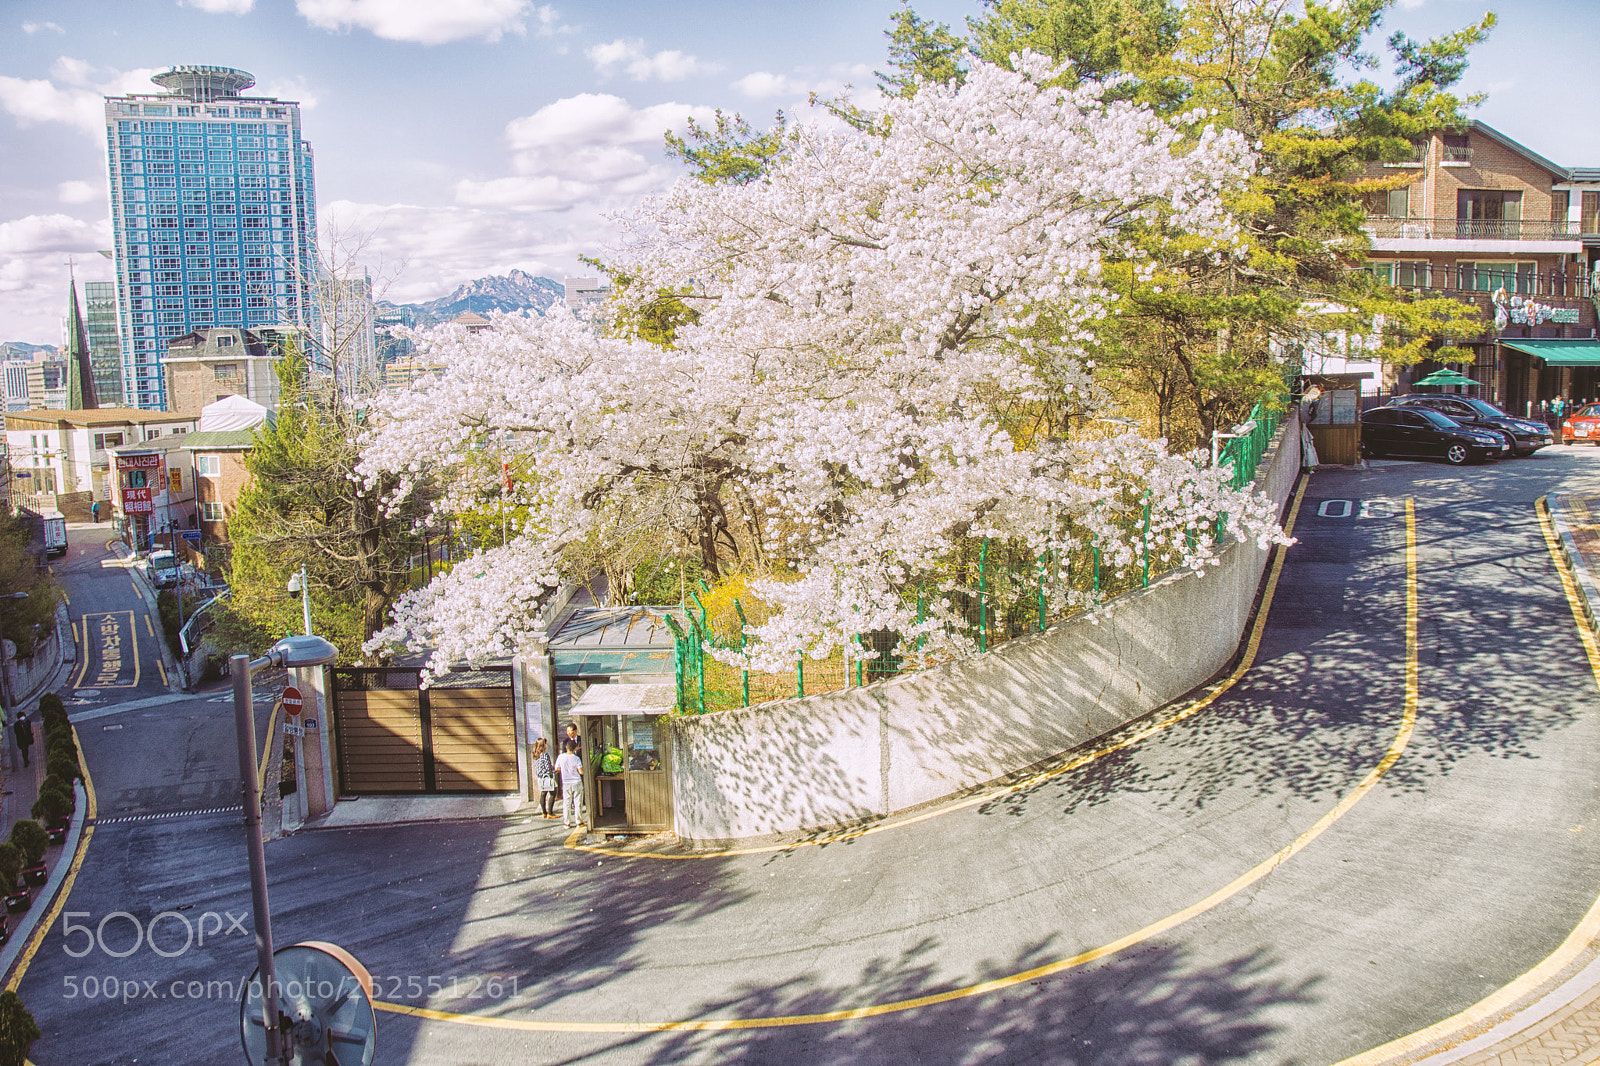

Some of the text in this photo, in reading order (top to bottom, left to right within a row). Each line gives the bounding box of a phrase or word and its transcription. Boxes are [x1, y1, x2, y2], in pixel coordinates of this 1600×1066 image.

[180, 65, 235, 75] PLATINUM
[1552, 308, 1579, 323] COFFEE
[117, 455, 158, 468] 현대사진관
[126, 489, 147, 500] 現代
[94, 614, 121, 686] 소방차통행로
